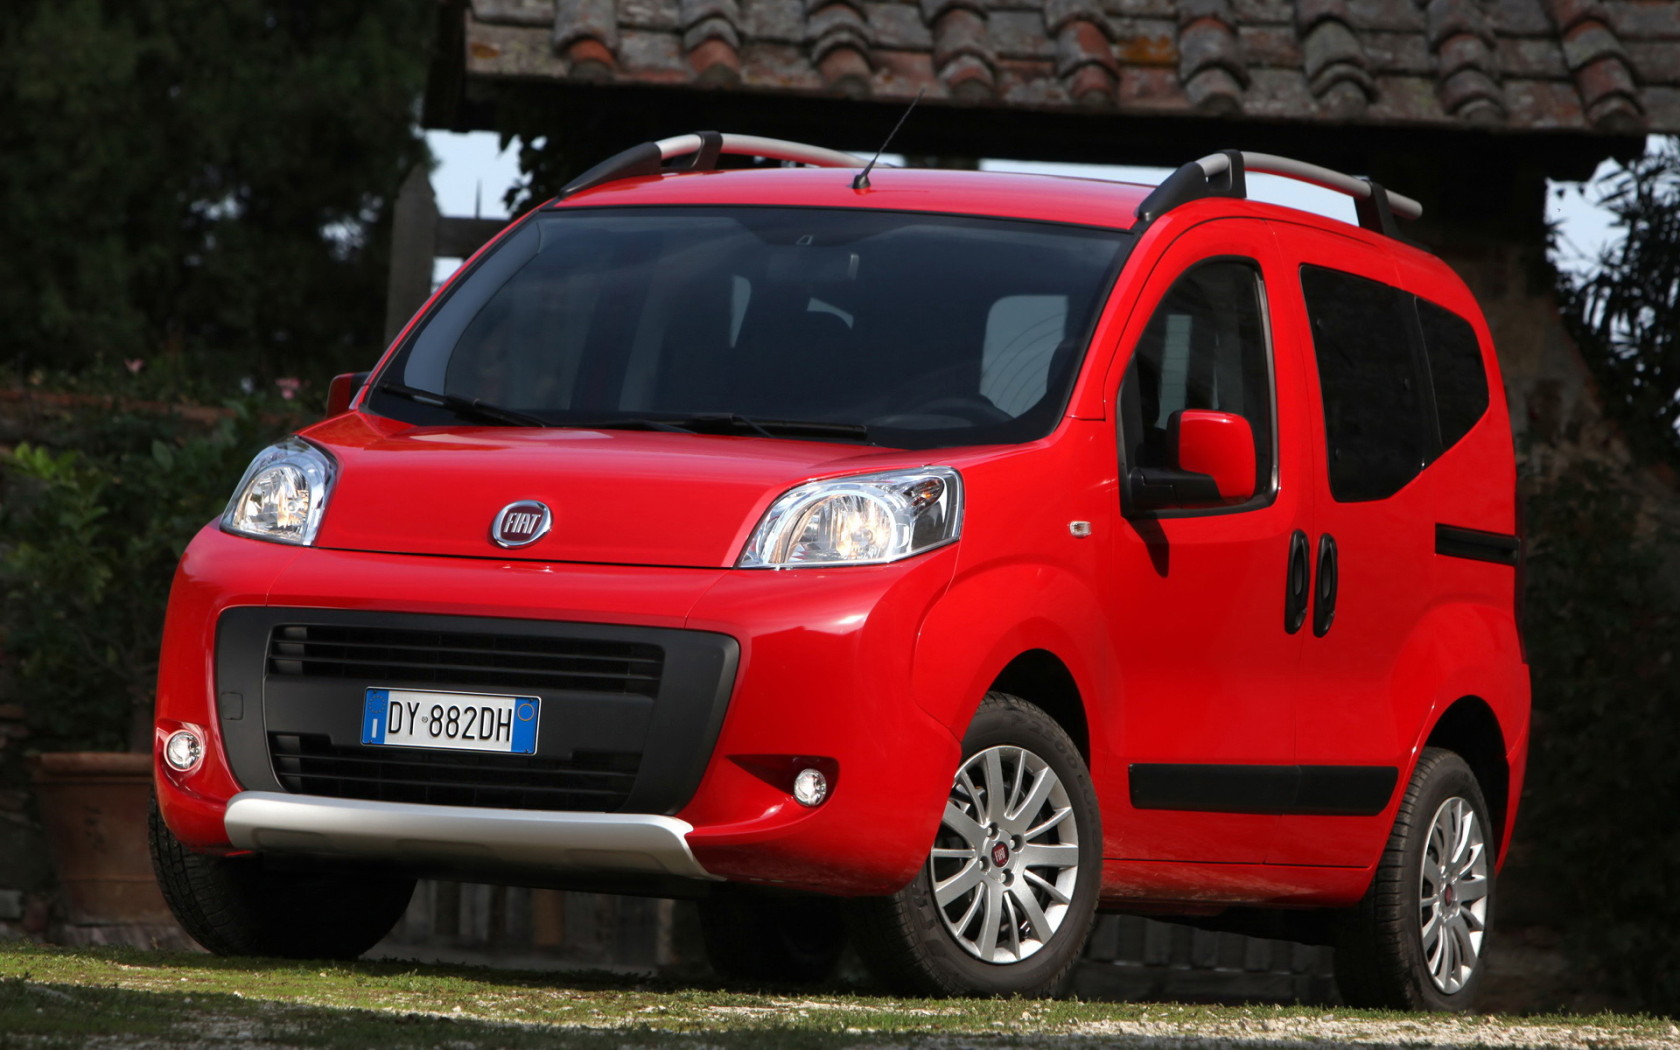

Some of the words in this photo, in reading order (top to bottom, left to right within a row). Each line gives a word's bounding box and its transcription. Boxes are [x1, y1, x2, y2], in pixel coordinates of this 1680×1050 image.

[503, 512, 541, 534] FIAT
[388, 701, 420, 735] DY
[429, 704, 512, 742] 882DH
